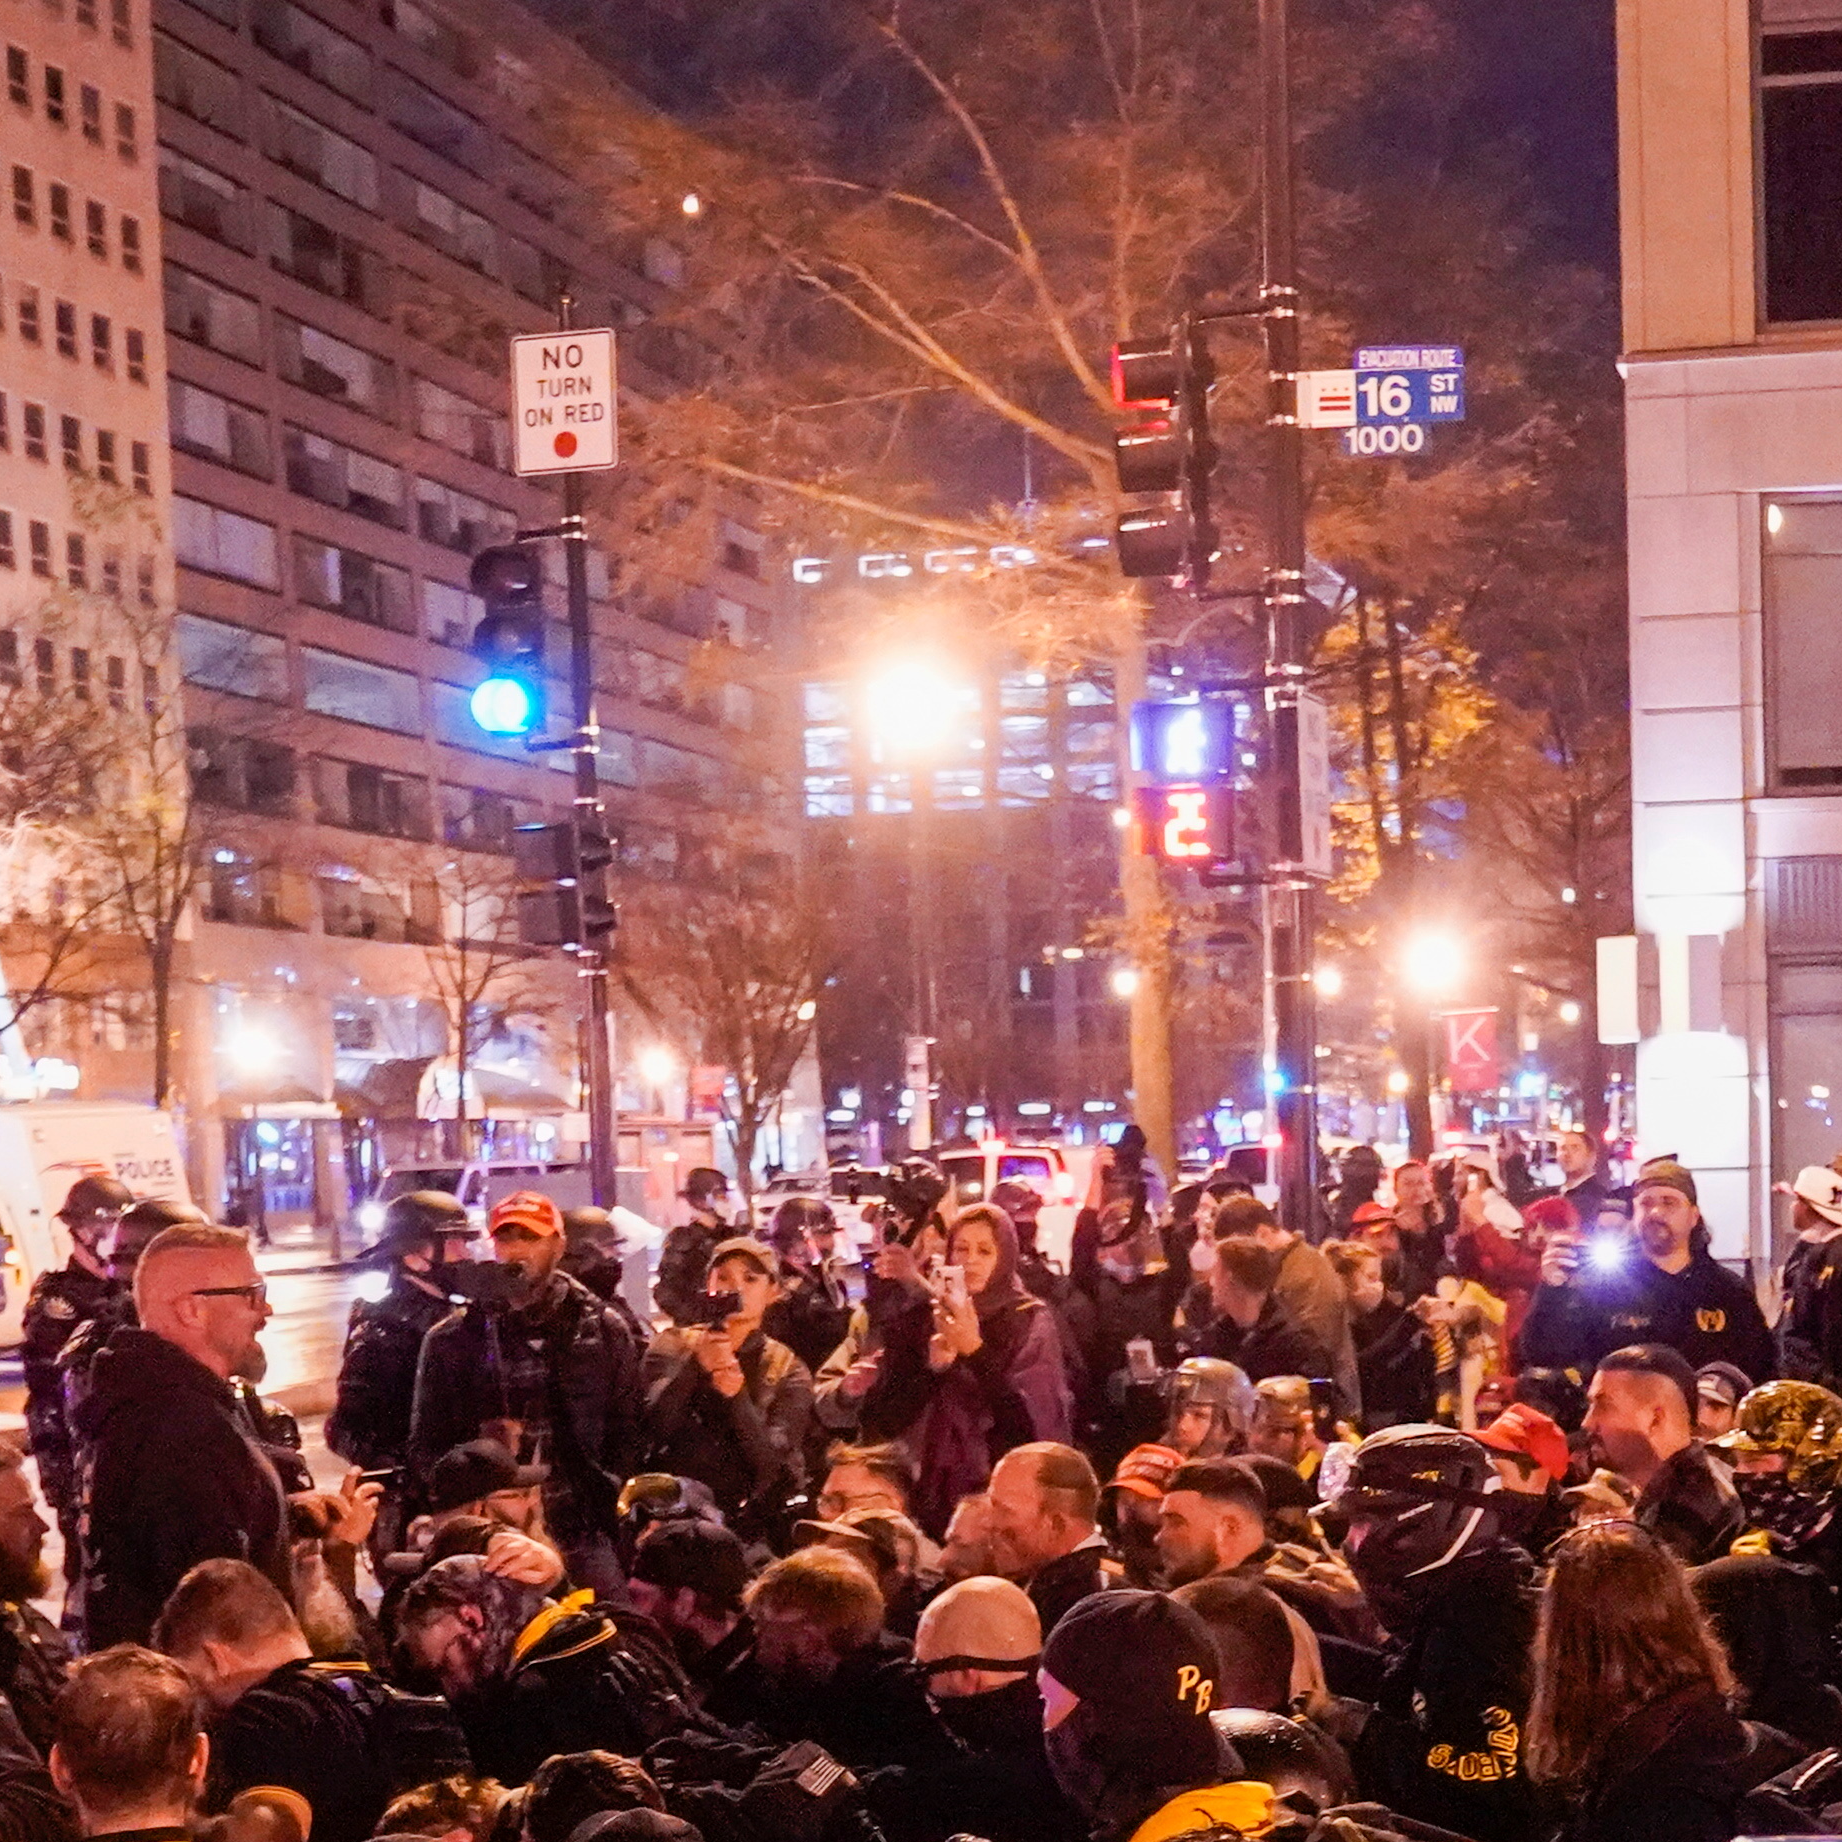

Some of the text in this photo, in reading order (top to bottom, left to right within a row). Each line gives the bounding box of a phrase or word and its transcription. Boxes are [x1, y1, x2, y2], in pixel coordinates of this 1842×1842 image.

[542, 344, 584, 370] NO
[536, 376, 592, 399] TURN
[1358, 373, 1459, 416] 16 ST
[525, 402, 604, 428] ON RED
[1430, 395, 1458, 414] NW
[1345, 424, 1424, 454] 1000
[1448, 1016, 1491, 1065] K
[114, 1158, 175, 1180] POLICE
